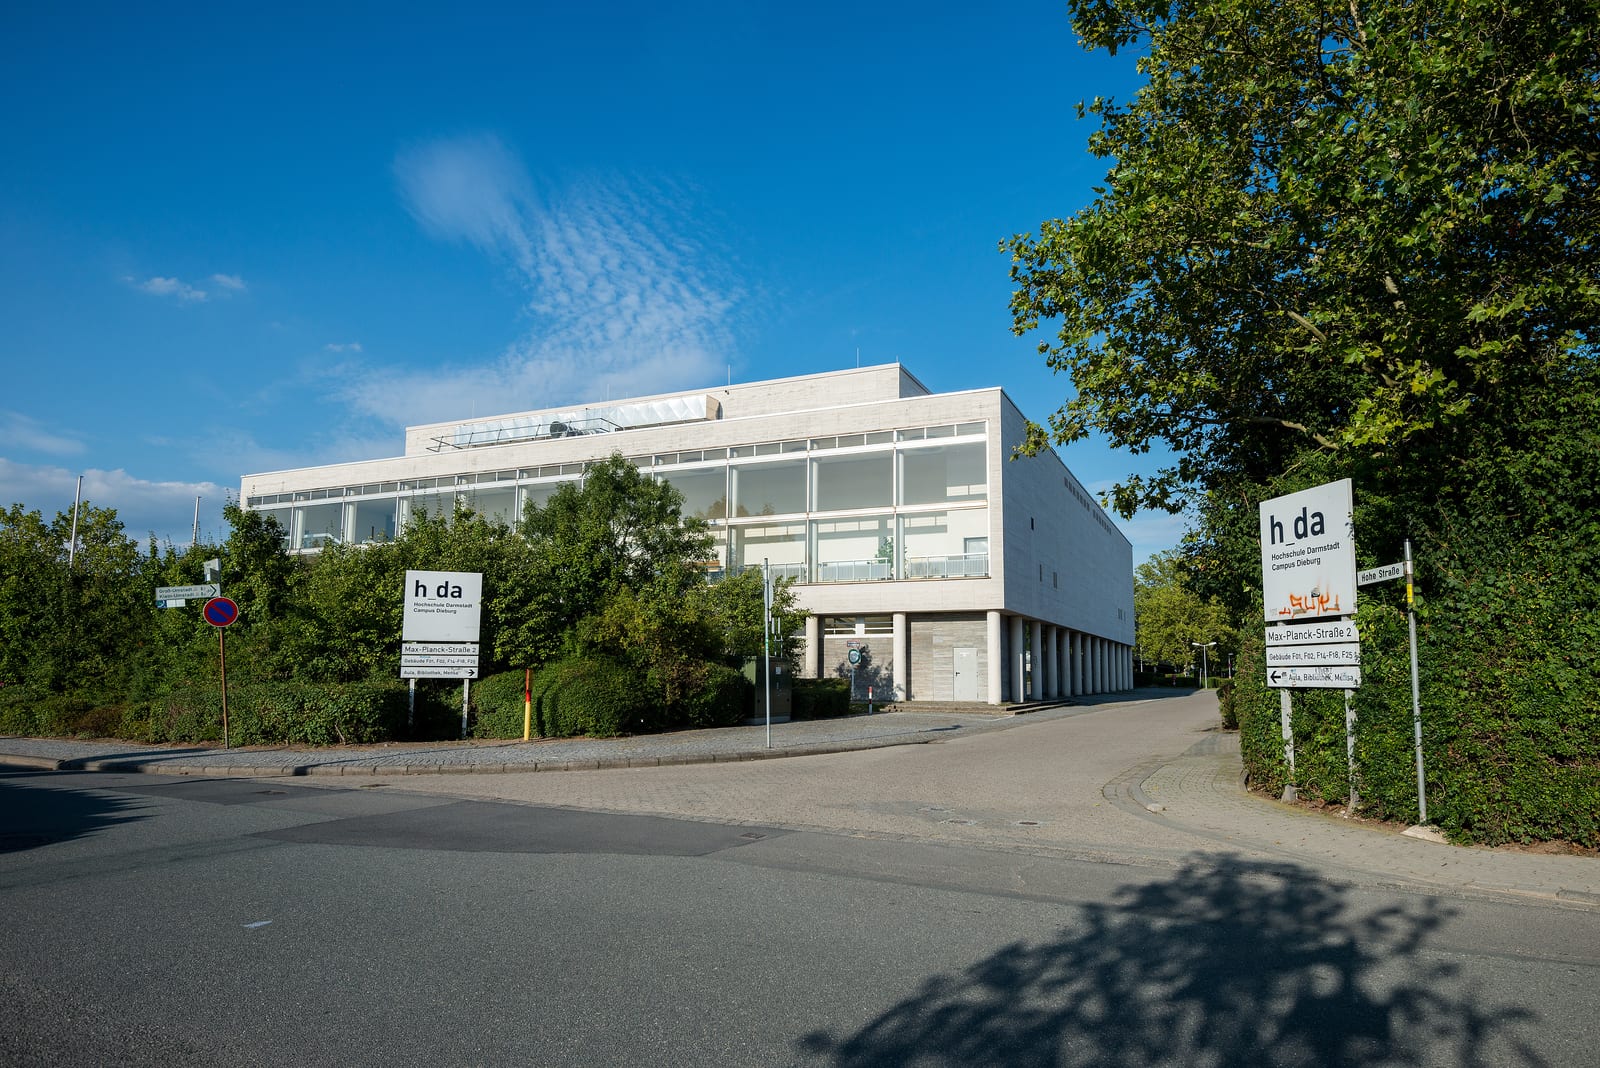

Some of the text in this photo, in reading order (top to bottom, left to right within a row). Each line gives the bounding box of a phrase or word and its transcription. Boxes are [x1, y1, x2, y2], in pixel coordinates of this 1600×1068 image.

[1269, 506, 1325, 547] h_da
[1271, 541, 1341, 561] Hochschule Darmstadt
[1271, 556, 1321, 571] Campus Dieburg
[1361, 566, 1400, 582] Hohe Straße
[414, 579, 463, 601] h_da
[1268, 627, 1352, 641] Max-Planck-Straße 2
[1269, 650, 1353, 661] Gebäude F01, F02, F14-F18, F25
